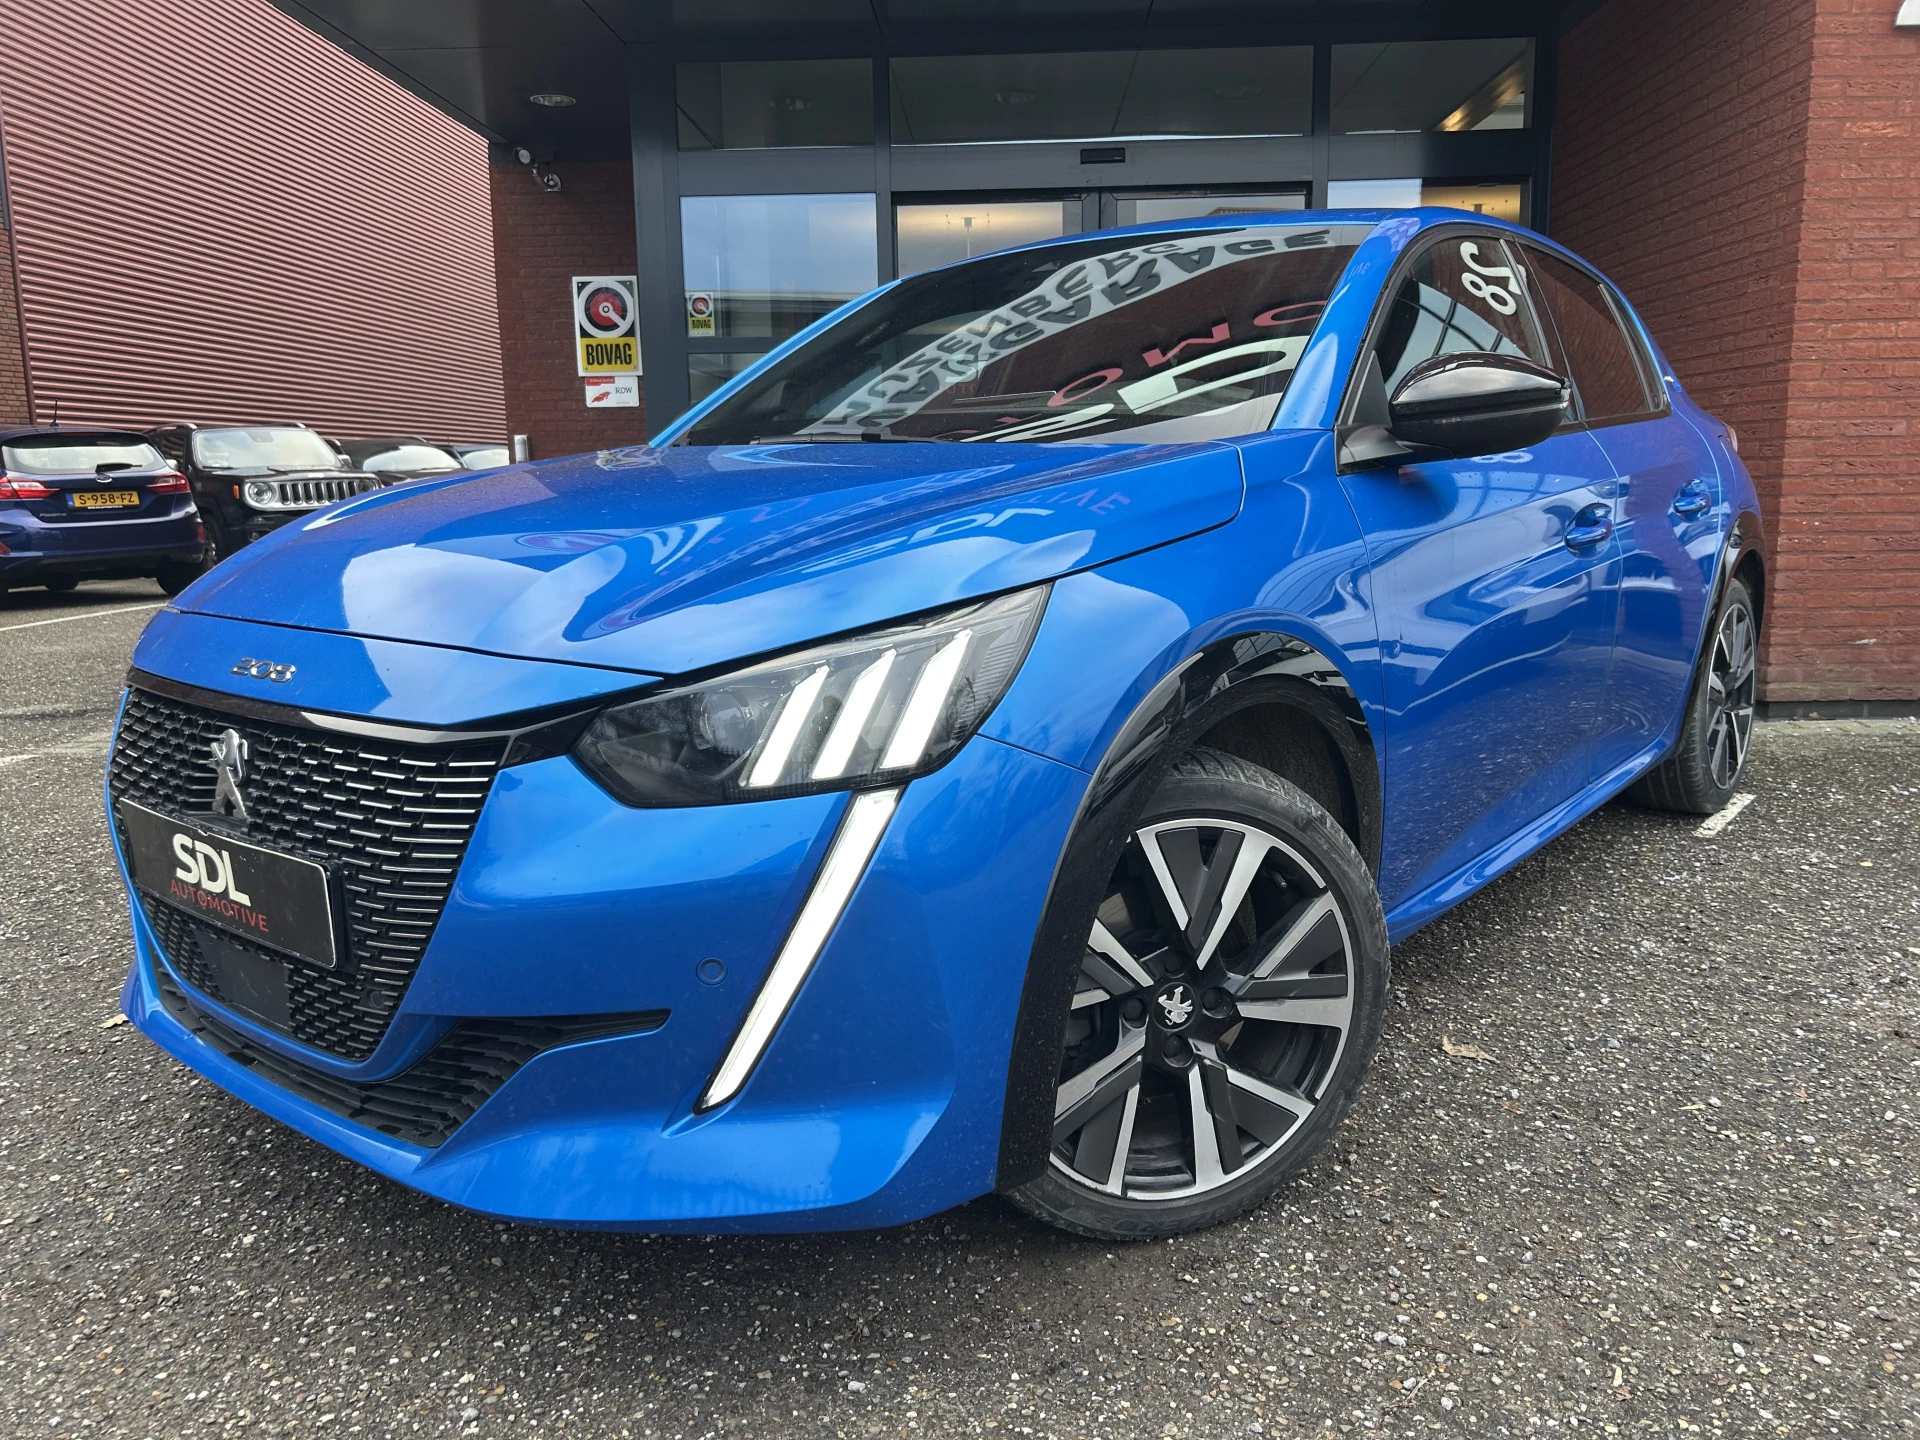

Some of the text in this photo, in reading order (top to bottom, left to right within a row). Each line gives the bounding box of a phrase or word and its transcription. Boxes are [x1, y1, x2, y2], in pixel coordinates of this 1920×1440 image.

[691, 319, 712, 329] BOVAG
[585, 342, 632, 366] BOVAG
[79, 493, 134, 505] S-958-FZ
[230, 657, 296, 683] 208
[173, 833, 251, 906] SDL
[170, 879, 269, 932] AUTOMOTIVE
